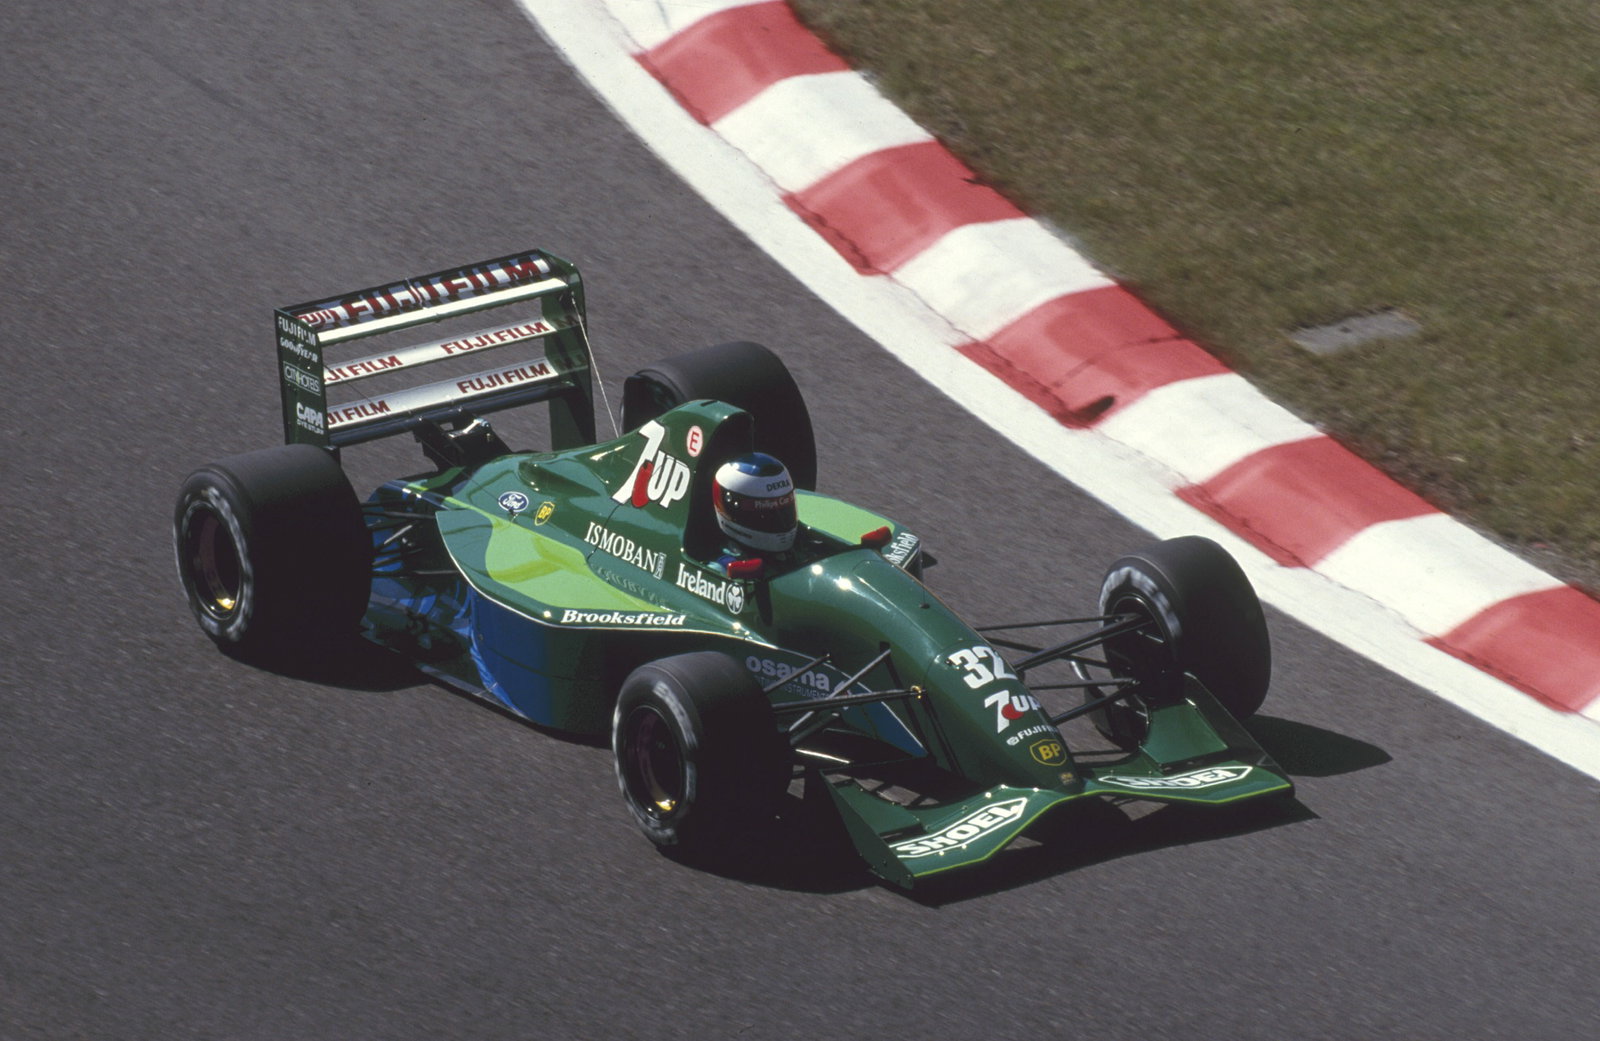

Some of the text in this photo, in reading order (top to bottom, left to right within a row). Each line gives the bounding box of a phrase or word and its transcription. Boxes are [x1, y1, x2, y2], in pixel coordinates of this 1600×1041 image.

[278, 315, 317, 346] FUJIFILM
[440, 321, 550, 355] FUJIFILM
[325, 355, 404, 382] JIFILM
[456, 362, 551, 394] FUJIFILM
[327, 400, 392, 425] JIFILM
[689, 431, 700, 452] E
[765, 480, 790, 492] DEKRA
[584, 521, 658, 574] ISMOBAN
[676, 562, 727, 606] Ireland
[560, 609, 686, 627] Brooksfield
[948, 645, 1018, 689] 32
[1038, 743, 1061, 761] BP
